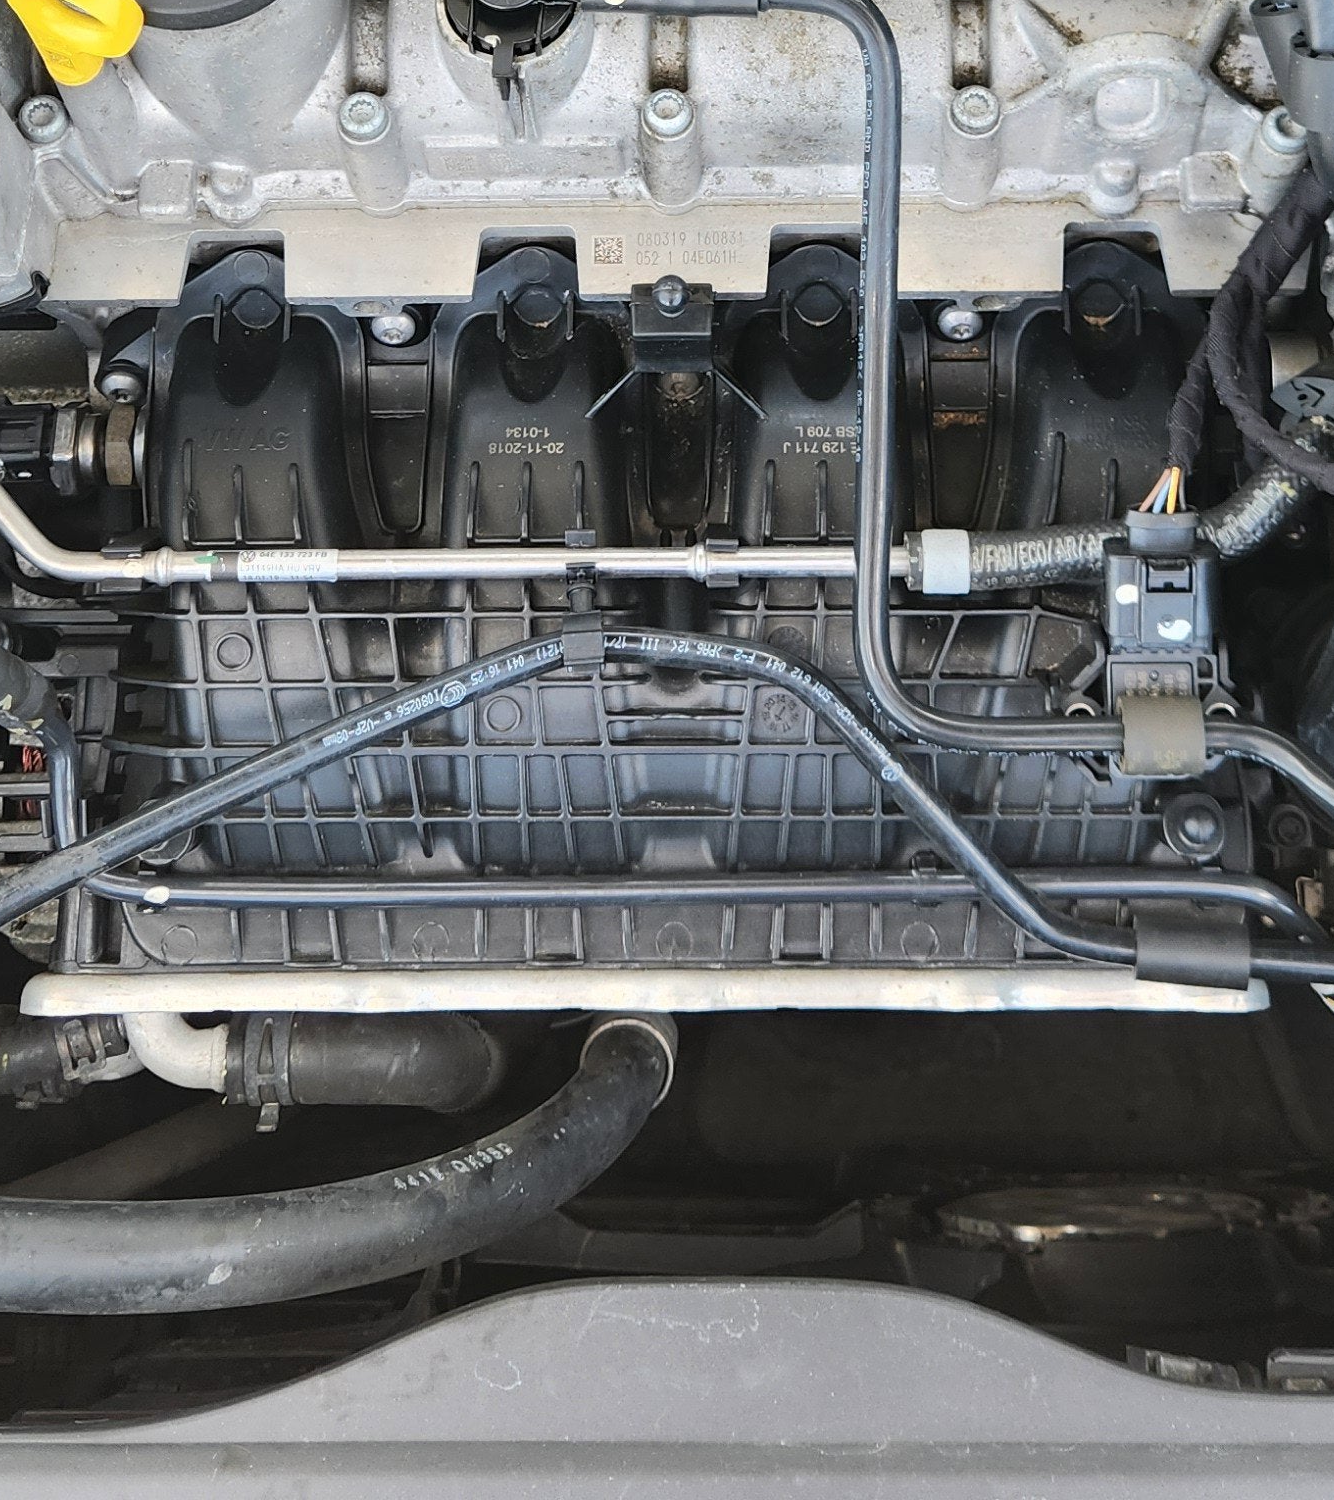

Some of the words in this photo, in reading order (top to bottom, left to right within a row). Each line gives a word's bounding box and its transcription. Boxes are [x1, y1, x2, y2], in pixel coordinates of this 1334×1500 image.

[864, 99, 874, 153] POLAND
[637, 231, 687, 247] 080319
[697, 231, 744, 246] 160831
[636, 250, 659, 266] 052
[505, 426, 551, 438] 1-0134
[795, 426, 804, 438] L
[807, 426, 832, 438] 709
[488, 442, 565, 454] 20-11-2018
[783, 442, 791, 454] J
[795, 442, 819, 454] 711
[822, 442, 847, 454] 129
[507, 654, 525, 671] 041
[733, 648, 755, 664] F-2
[765, 654, 787, 672] 041
[791, 666, 812, 684] 612
